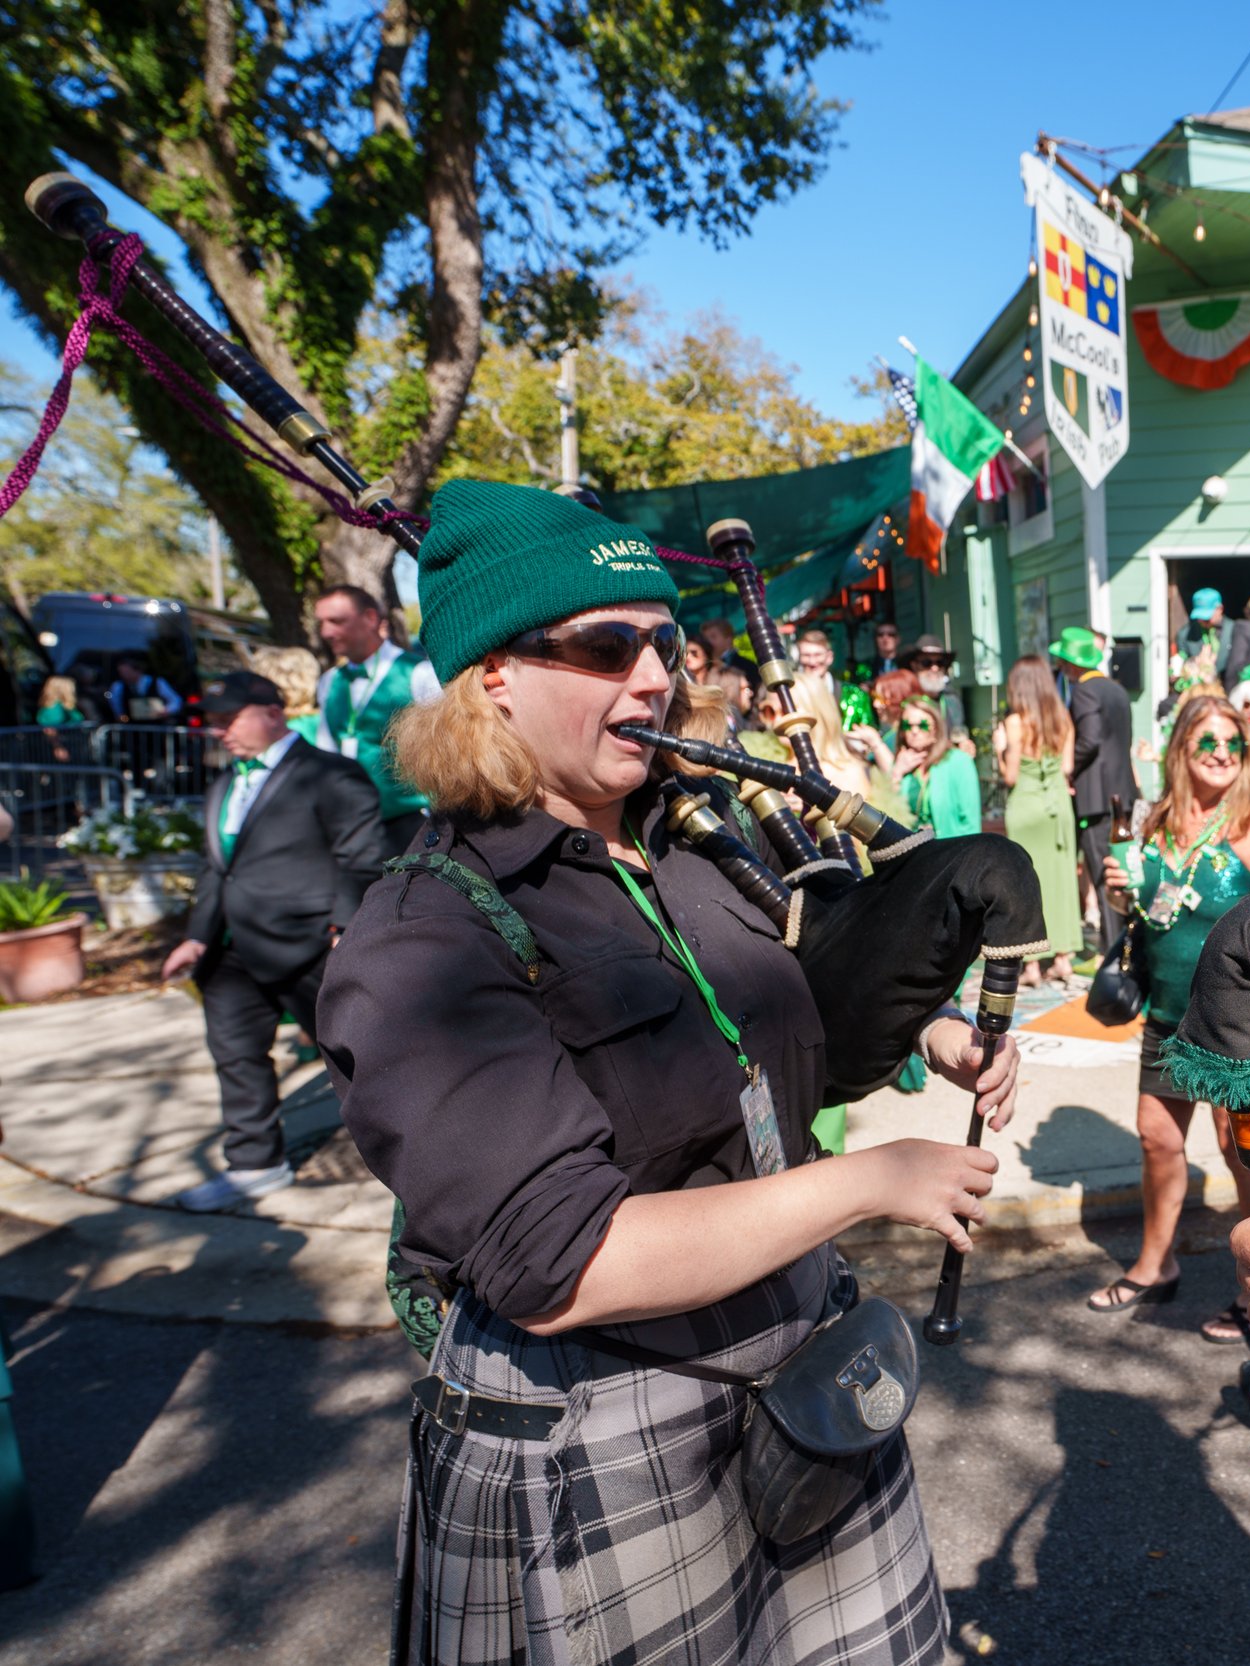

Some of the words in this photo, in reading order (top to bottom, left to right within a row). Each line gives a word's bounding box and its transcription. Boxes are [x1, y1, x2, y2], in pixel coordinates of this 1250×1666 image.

[1050, 315, 1119, 376] McCool's
[1098, 436, 1120, 467] Pub
[590, 539, 655, 566] JAMES
